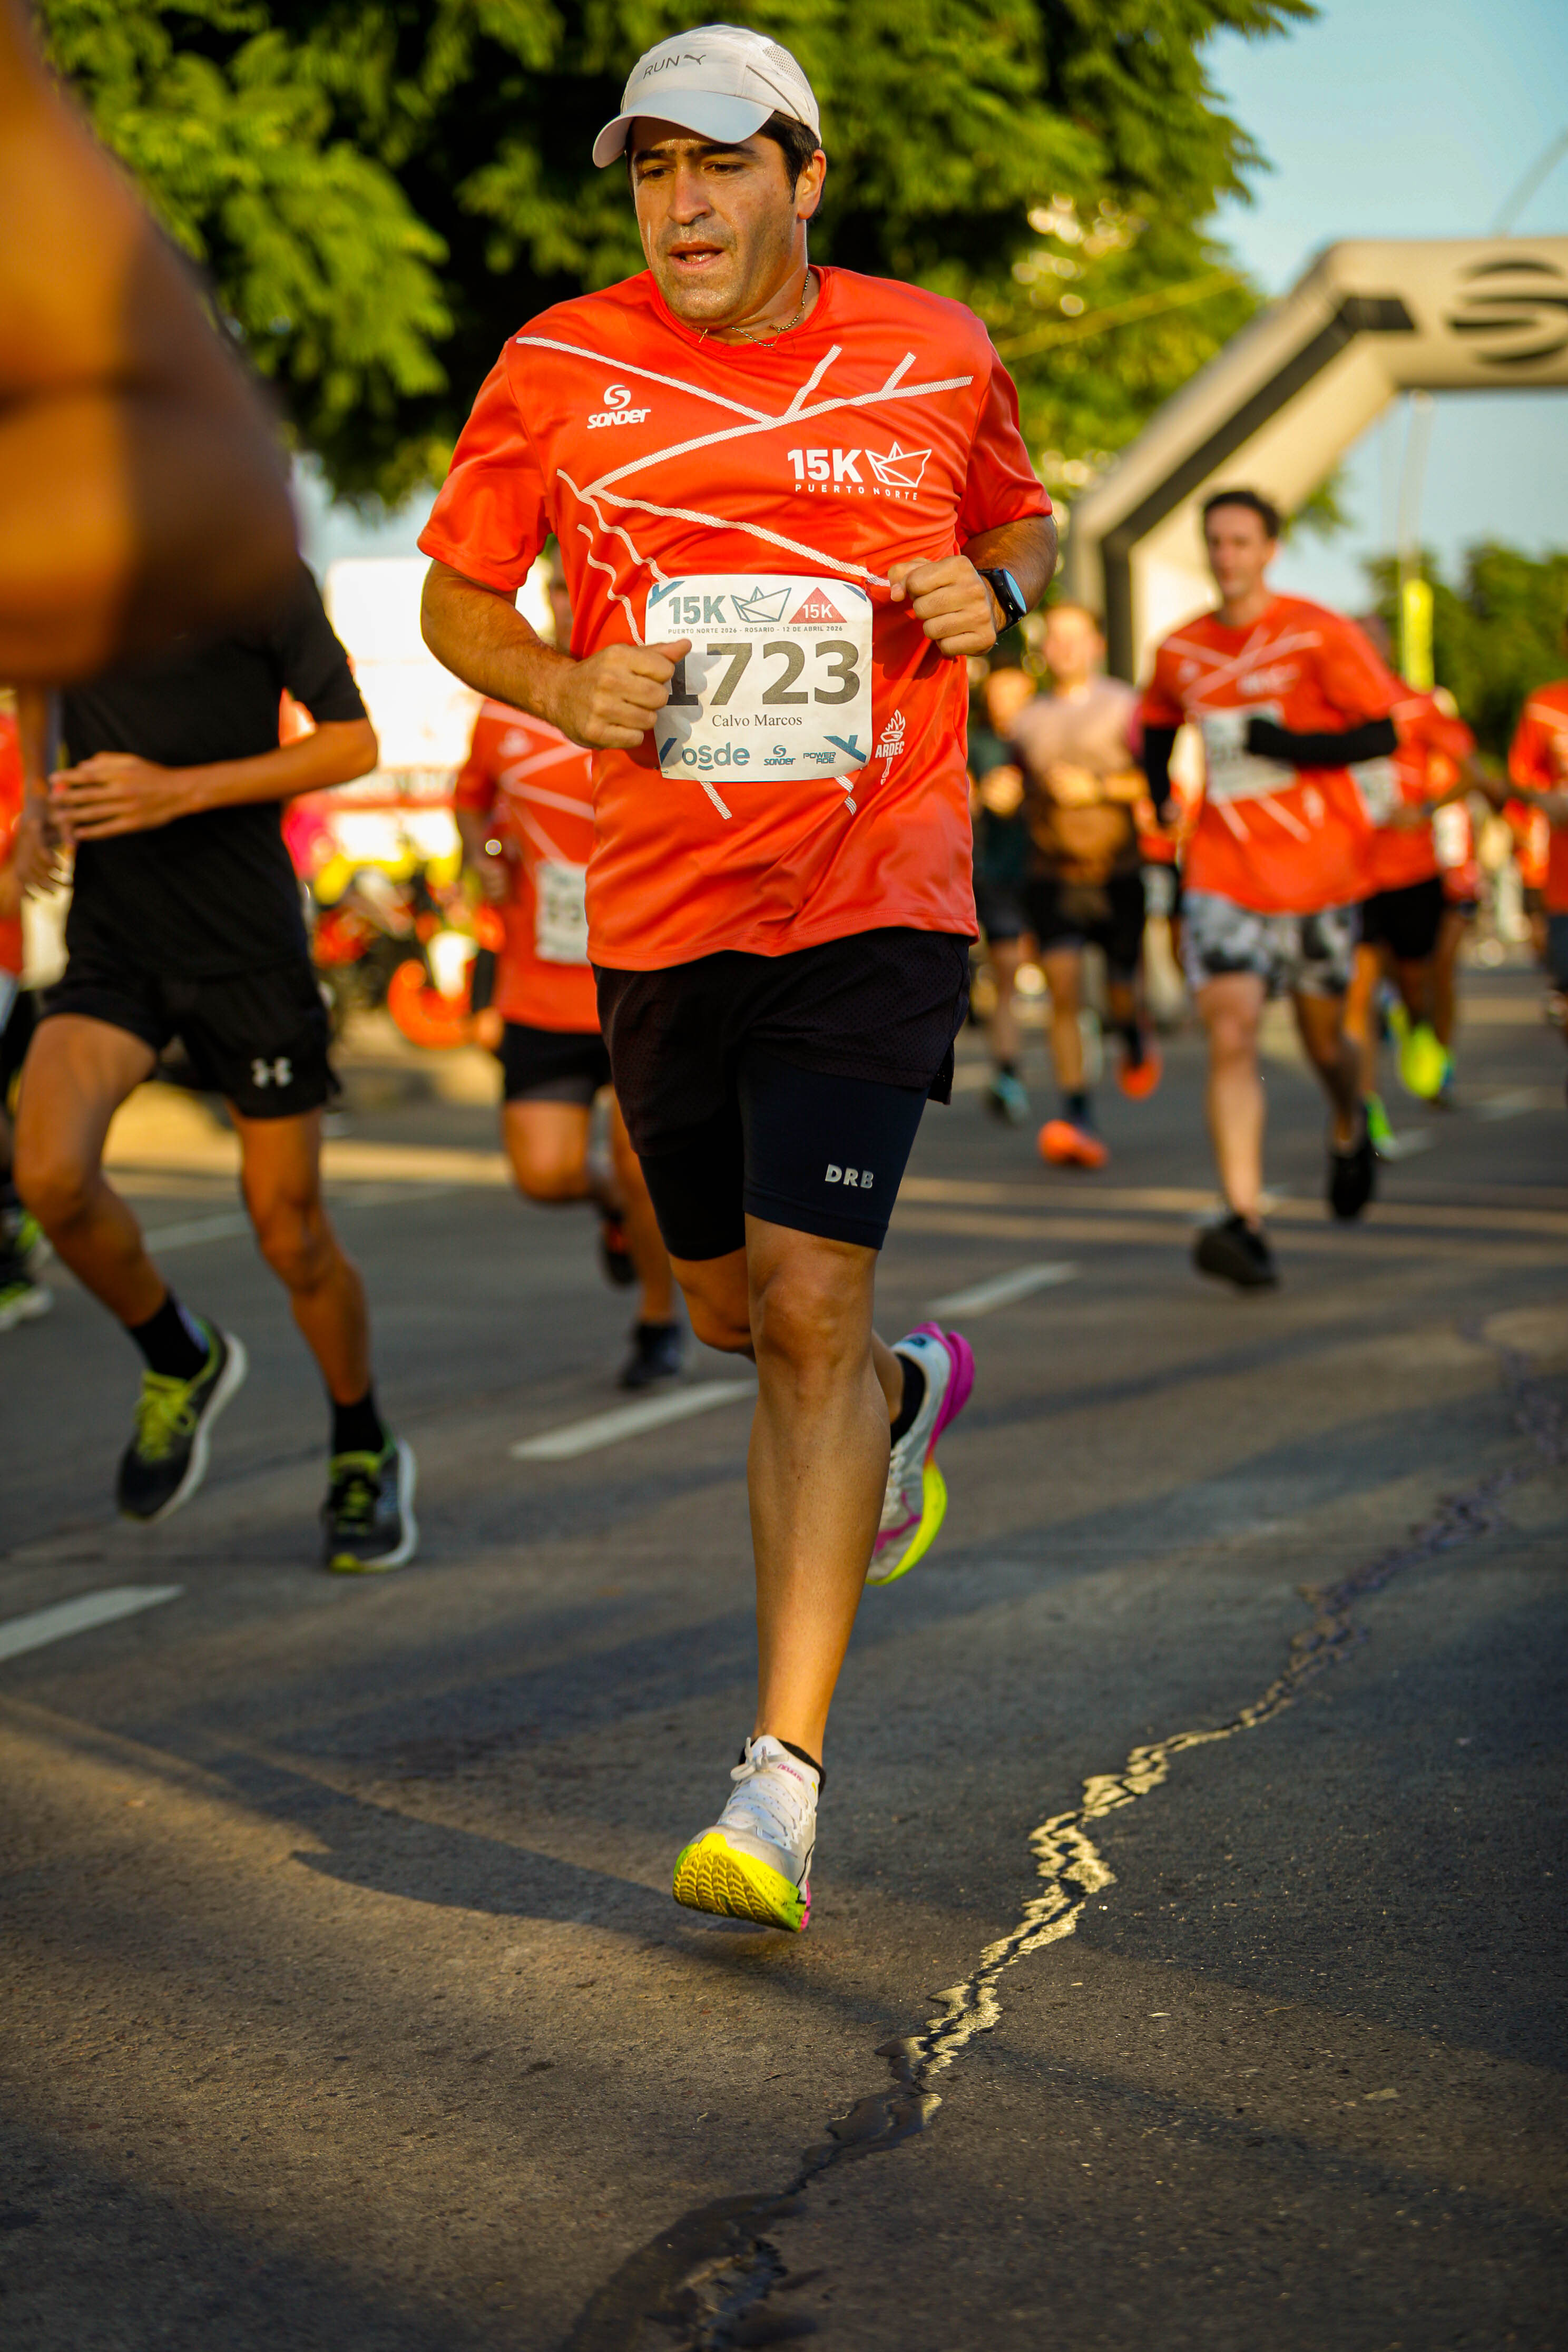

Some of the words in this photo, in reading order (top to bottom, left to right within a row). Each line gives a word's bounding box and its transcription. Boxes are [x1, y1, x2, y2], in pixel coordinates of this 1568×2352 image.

[643, 55, 680, 80] RUN
[787, 448, 863, 483] 15K
[795, 484, 865, 494] PUERTO
[873, 487, 917, 500] NORTE
[668, 595, 726, 624] 15K
[802, 603, 832, 619] 15K
[712, 714, 750, 727] Calvo
[754, 714, 802, 726] Marcos
[682, 742, 750, 767] osde
[875, 741, 905, 758] ARDEC
[825, 1163, 874, 1189] DRB
